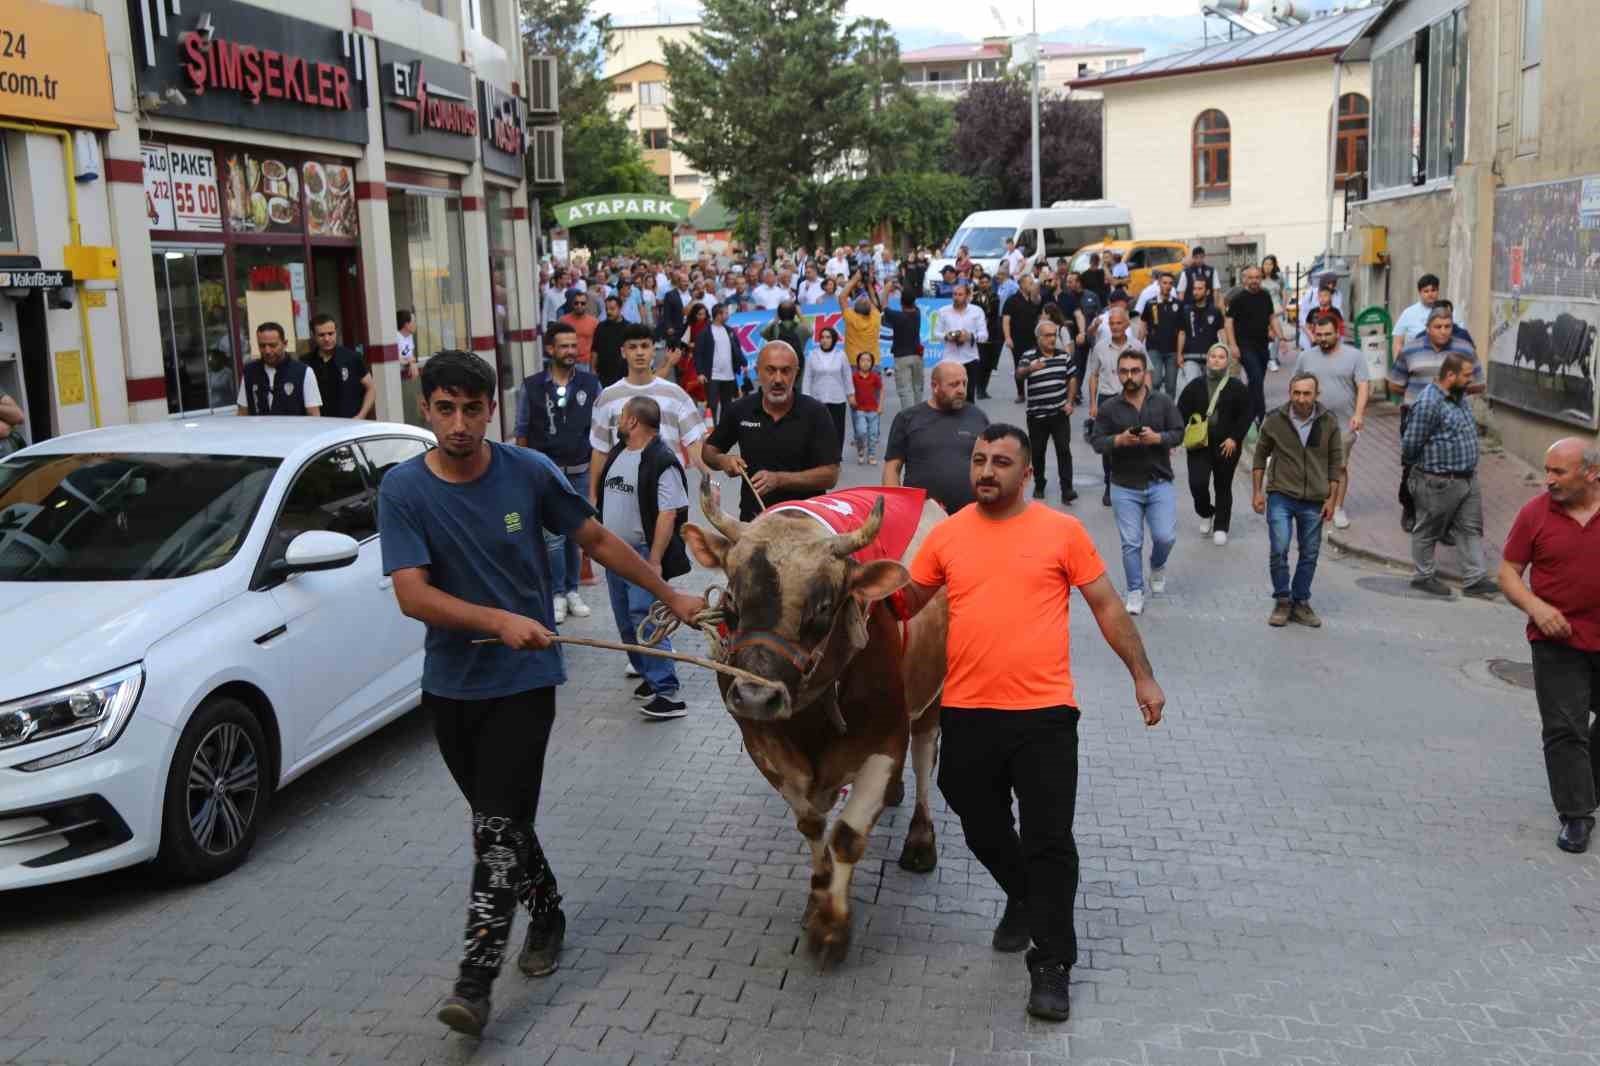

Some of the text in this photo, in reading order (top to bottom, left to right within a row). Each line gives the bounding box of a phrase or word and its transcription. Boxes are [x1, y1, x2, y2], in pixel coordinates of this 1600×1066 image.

[393, 61, 411, 97] ET
[171, 151, 213, 177] PAKET
[152, 180, 171, 200] 212
[568, 199, 674, 221] ATAPARK
